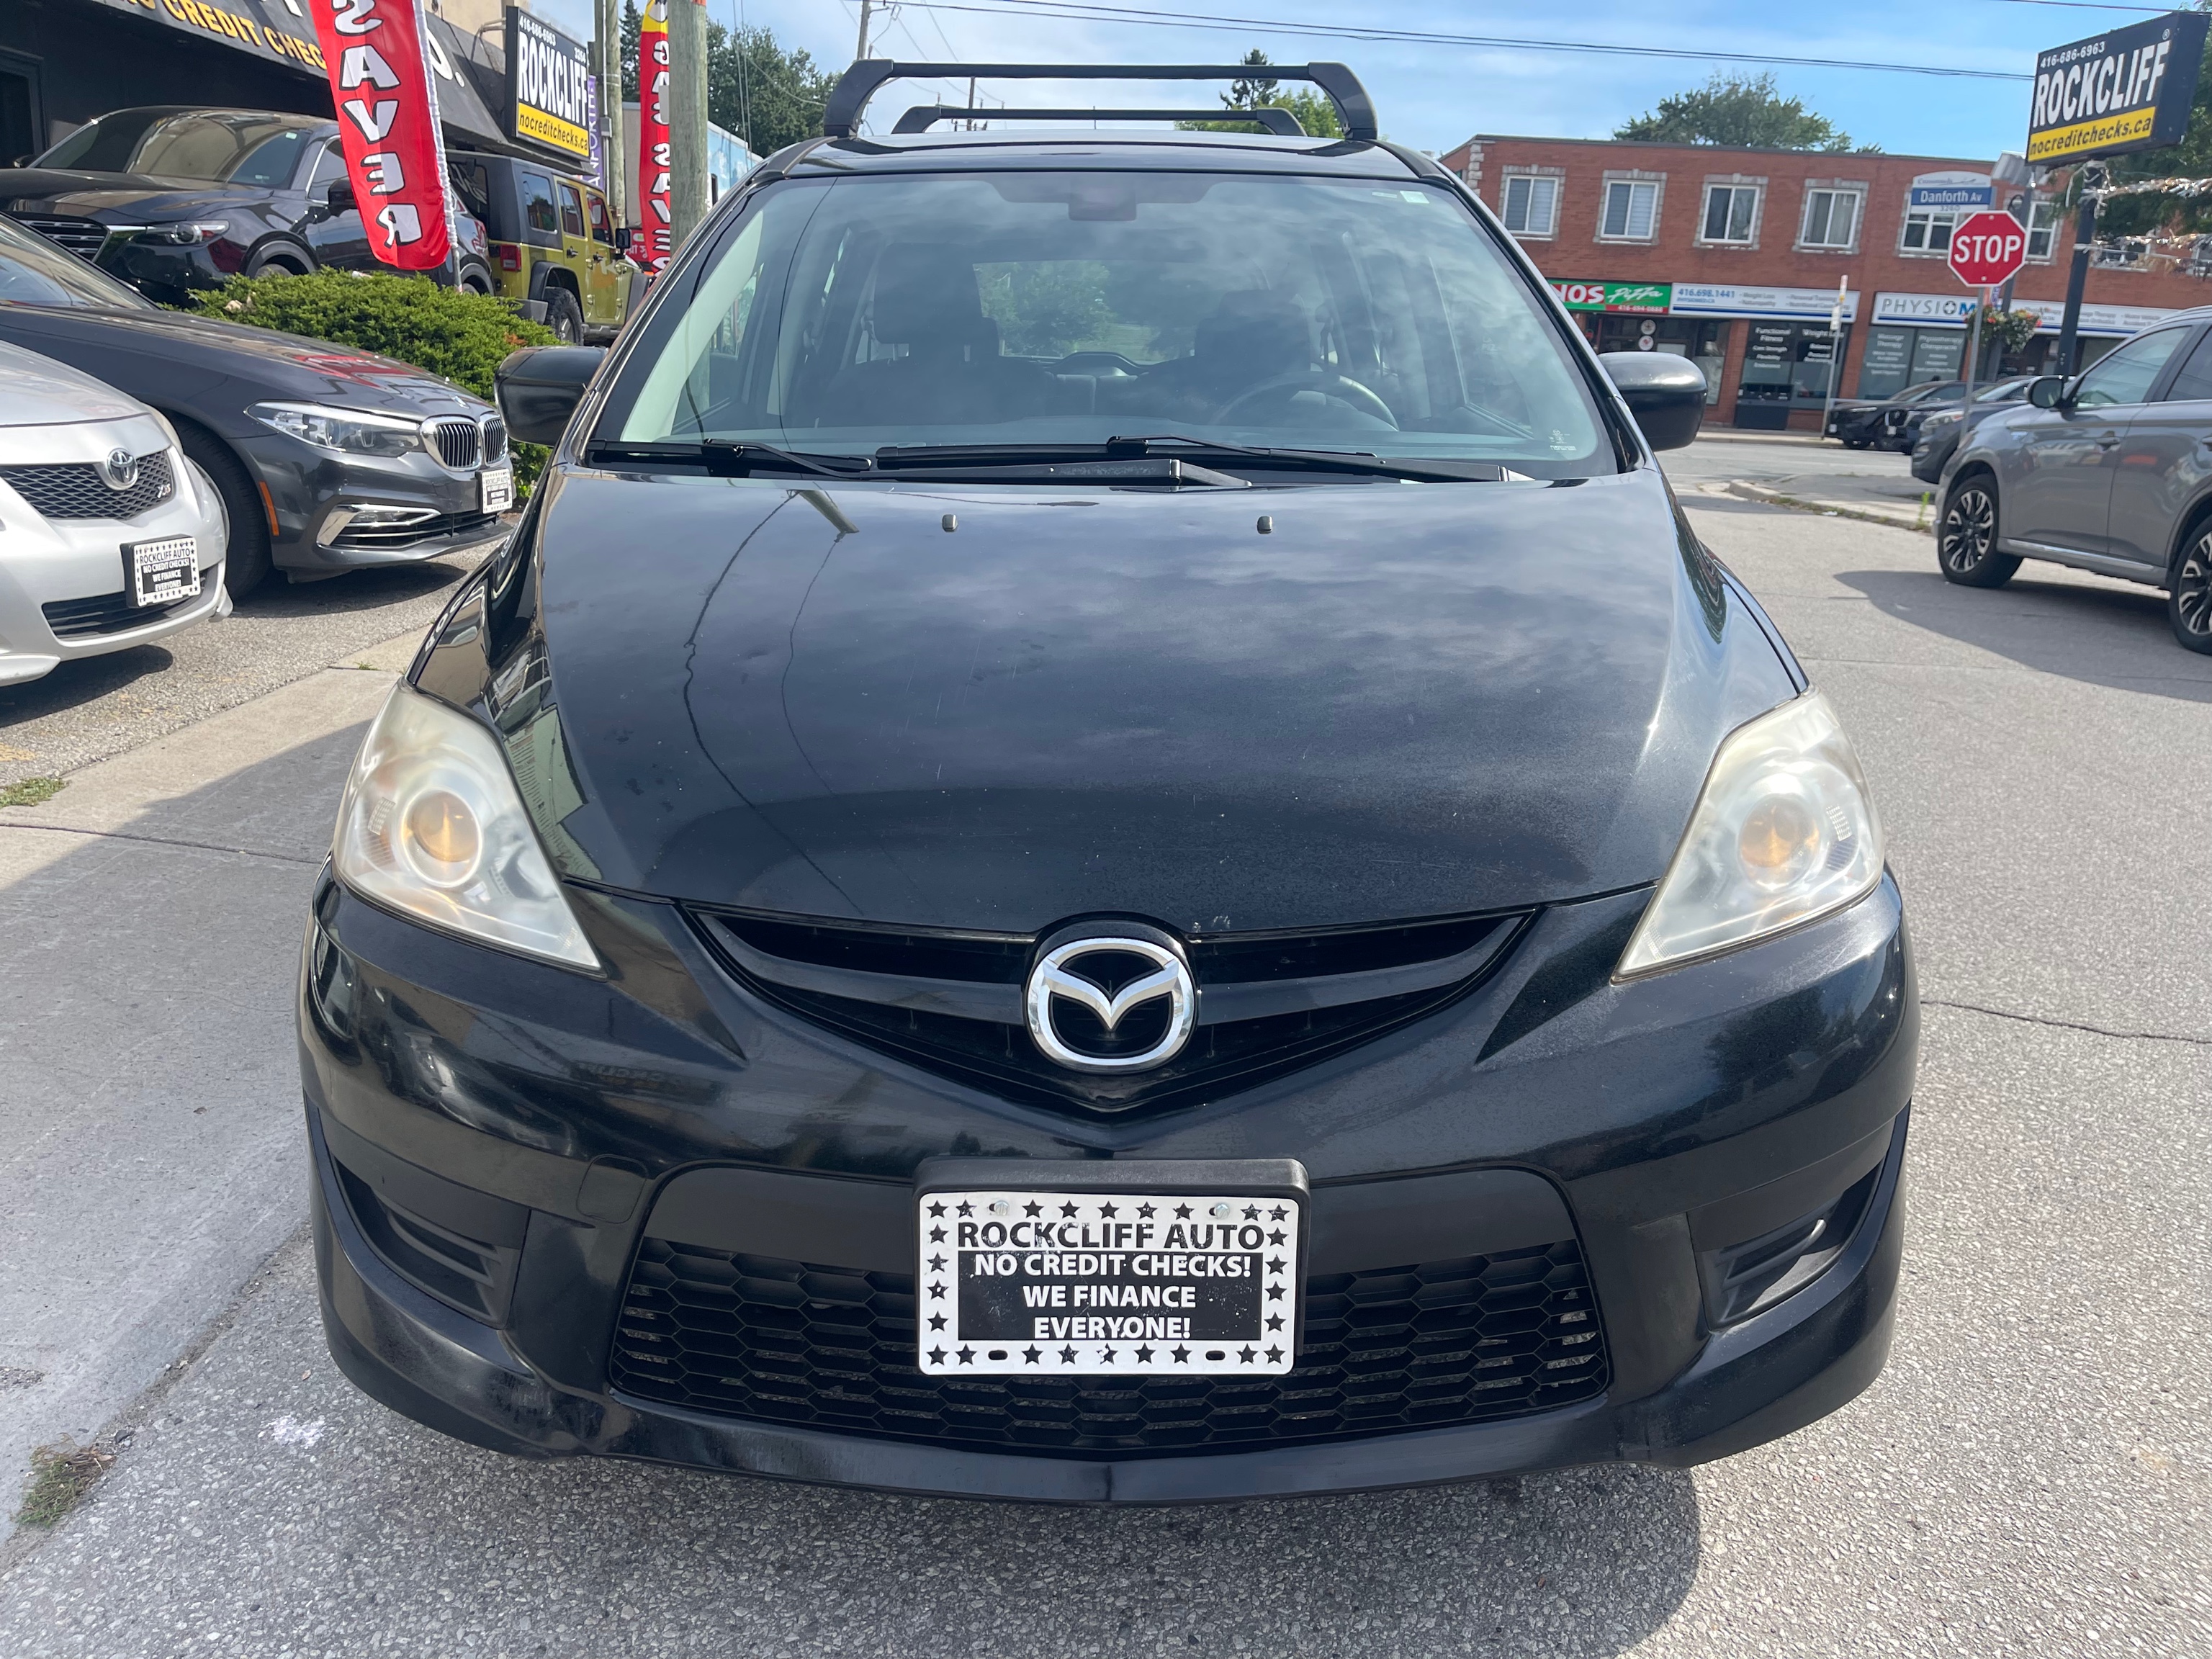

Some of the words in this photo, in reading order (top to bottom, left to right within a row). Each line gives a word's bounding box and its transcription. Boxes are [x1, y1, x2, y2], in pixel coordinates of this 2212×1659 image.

[163, 0, 262, 47] CREDIT
[262, 26, 328, 70] CHEC
[2040, 41, 2105, 68] 416-686-6963
[518, 31, 588, 127] ROCKCLIFF
[2033, 40, 2171, 128] ROCKCLIFF
[519, 113, 588, 150] nocreditchecks.ca
[2028, 117, 2152, 156] nocreditchecks.ca
[1920, 190, 1969, 203] Danforth
[1970, 192, 1982, 202] Av
[1954, 235, 2022, 264] STOP
[1550, 284, 1604, 304] NOS
[1607, 287, 1663, 303] Pizza
[1678, 288, 1735, 299] 416.698.1441
[1881, 298, 1977, 315] PHYSIOM
[140, 550, 172, 565] ROCKCLIFF
[173, 548, 191, 559] AUTO
[143, 565, 152, 574] NO
[152, 562, 169, 572] CREDIT
[152, 573, 161, 583] WE
[958, 1221, 1154, 1250] ROCKCLIFF
[1164, 1223, 1264, 1251] AUTO
[975, 1253, 1018, 1277] NO
[1024, 1253, 1125, 1277] CREDIT
[1132, 1254, 1252, 1278] CHECKS!
[1022, 1285, 1066, 1308] WE
[1074, 1284, 1197, 1308] FINANCE
[1033, 1316, 1191, 1340] EVERYONE!
